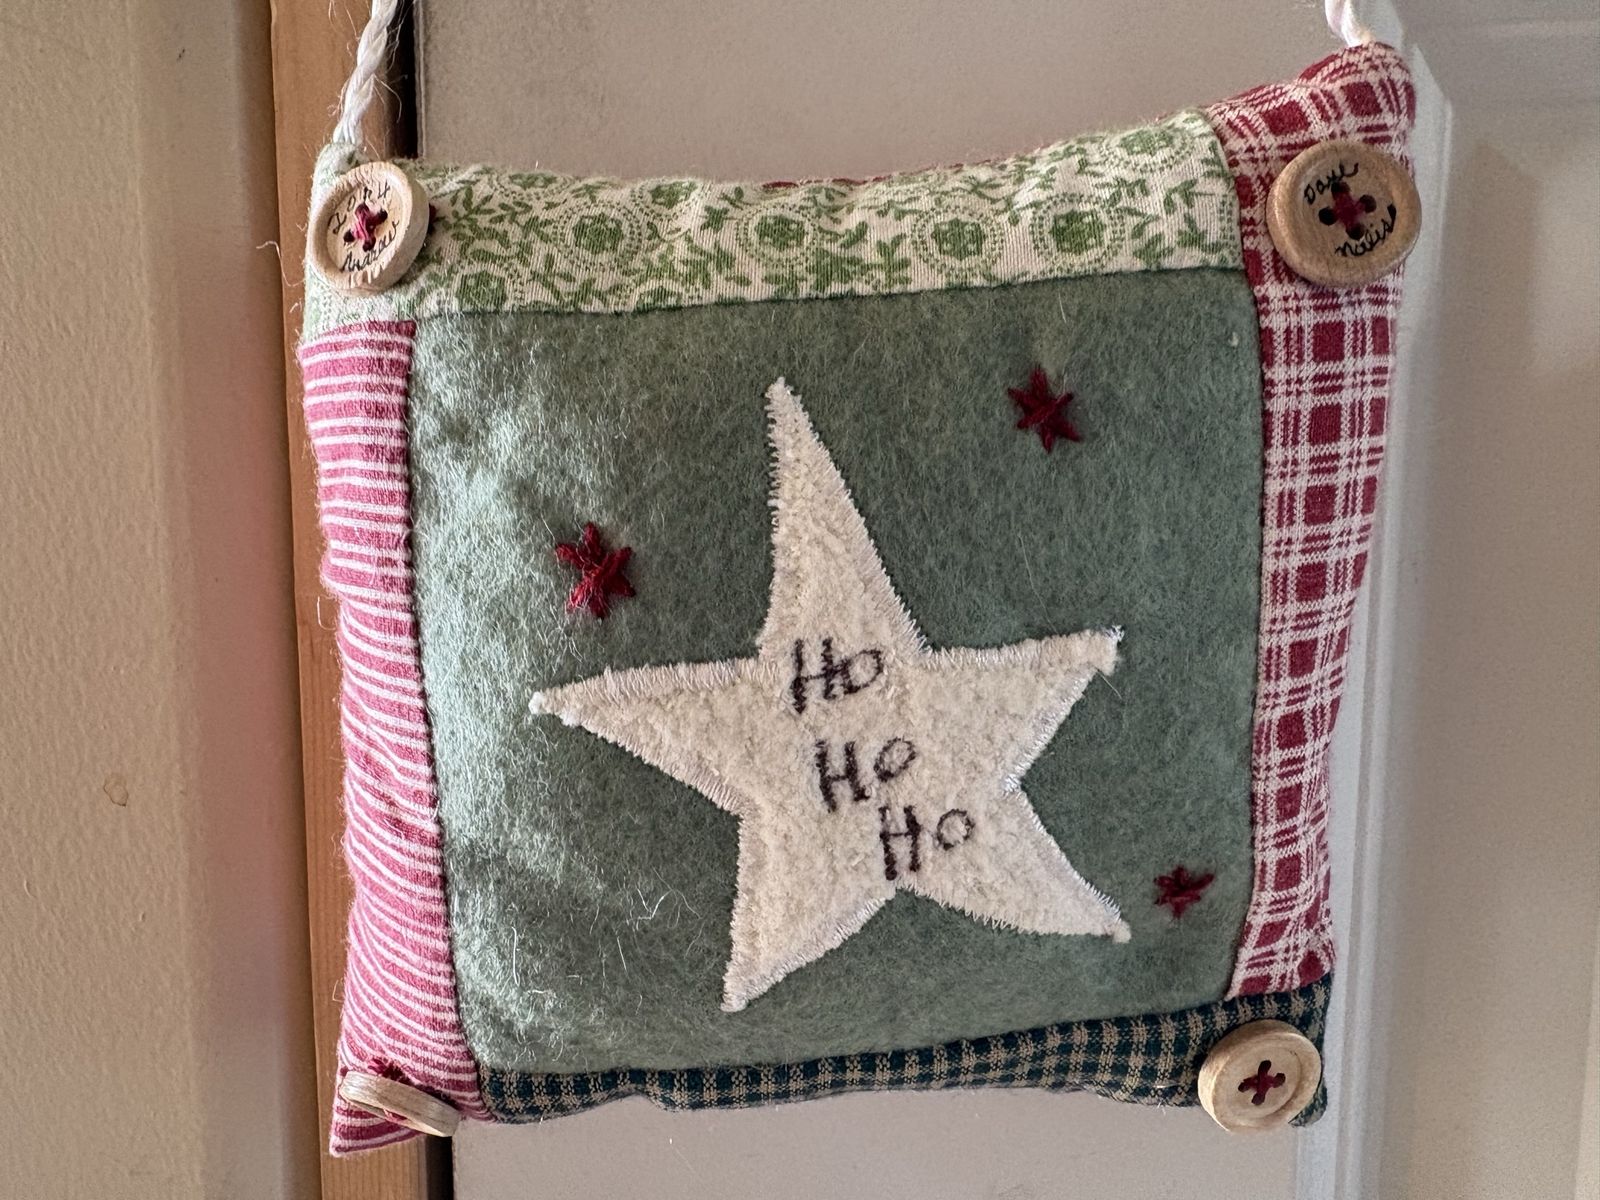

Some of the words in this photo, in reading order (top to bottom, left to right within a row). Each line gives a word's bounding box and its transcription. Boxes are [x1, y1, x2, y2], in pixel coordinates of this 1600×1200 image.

[790, 638, 884, 714] Ho
[815, 736, 916, 813] Ho
[878, 805, 975, 881] Ho
